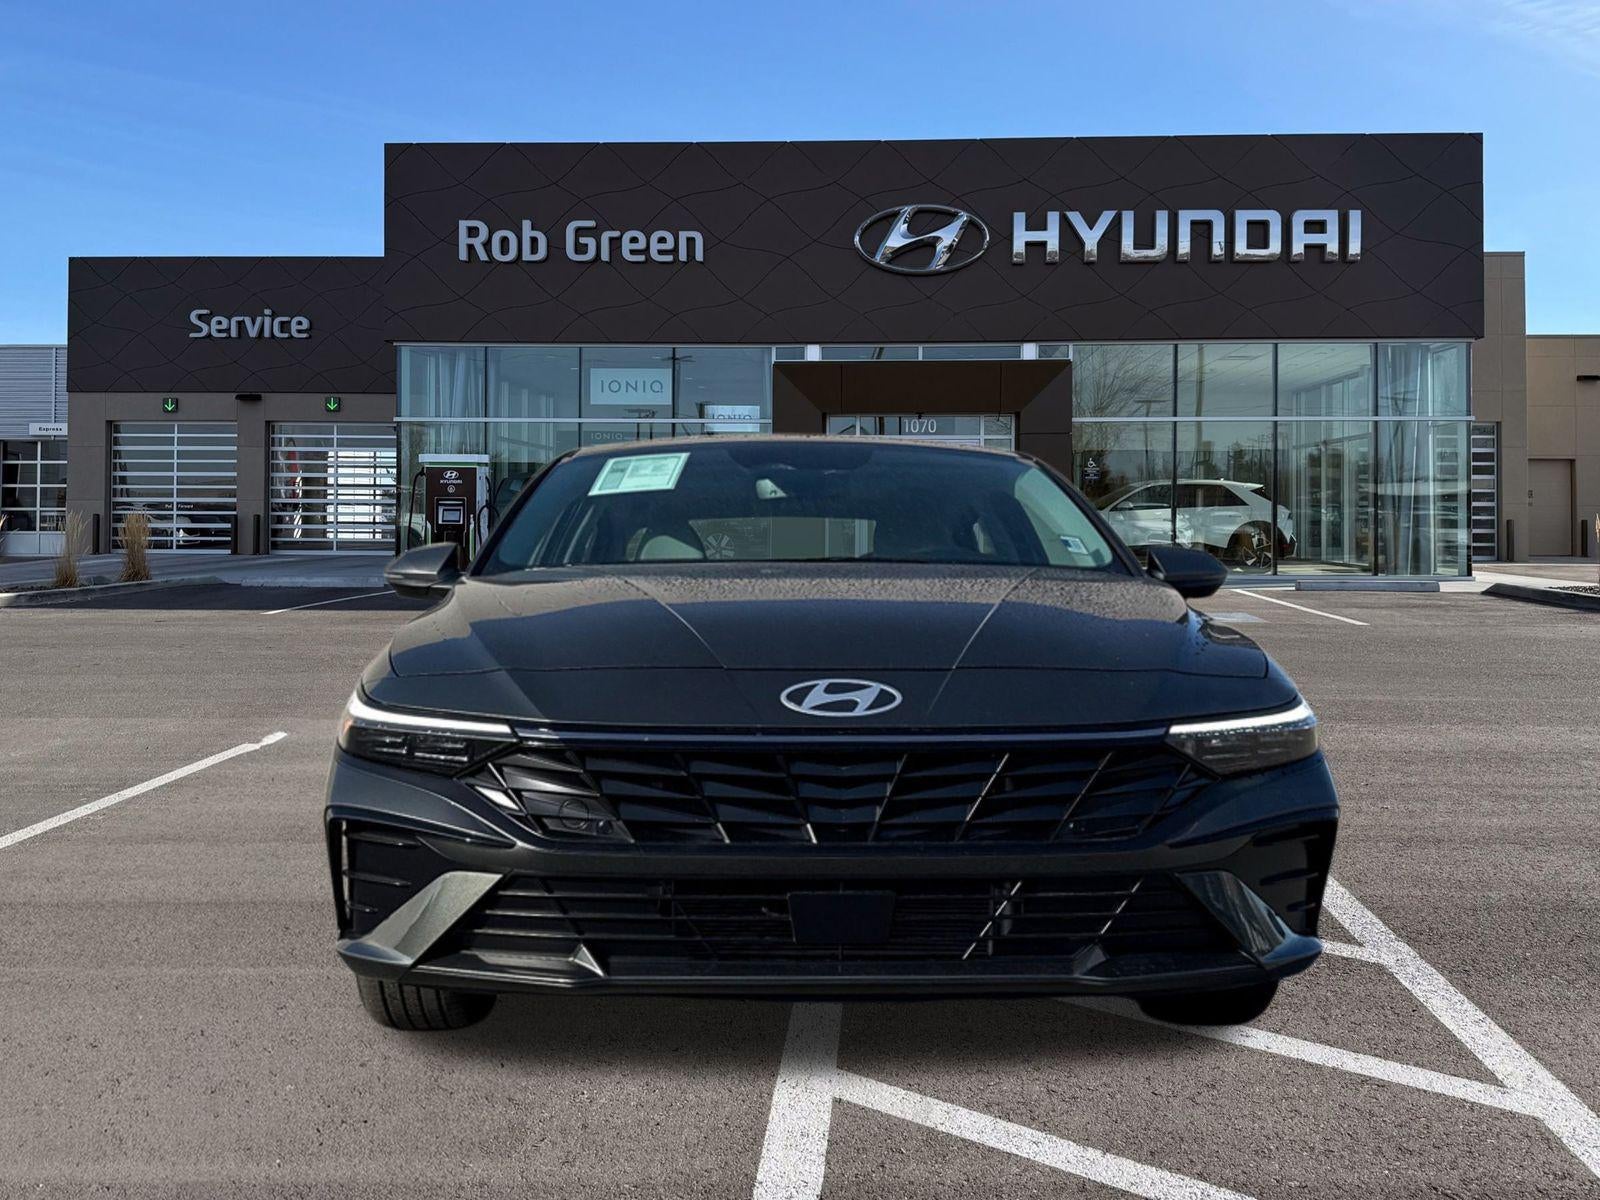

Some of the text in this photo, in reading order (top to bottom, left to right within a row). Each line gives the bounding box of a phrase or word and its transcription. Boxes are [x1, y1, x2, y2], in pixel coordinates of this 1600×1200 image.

[458, 219, 705, 263] Rob Green
[1011, 209, 1363, 264] HYUNDAI
[189, 308, 311, 339] Service
[600, 379, 664, 394] IONIQ
[904, 418, 937, 433] 1070
